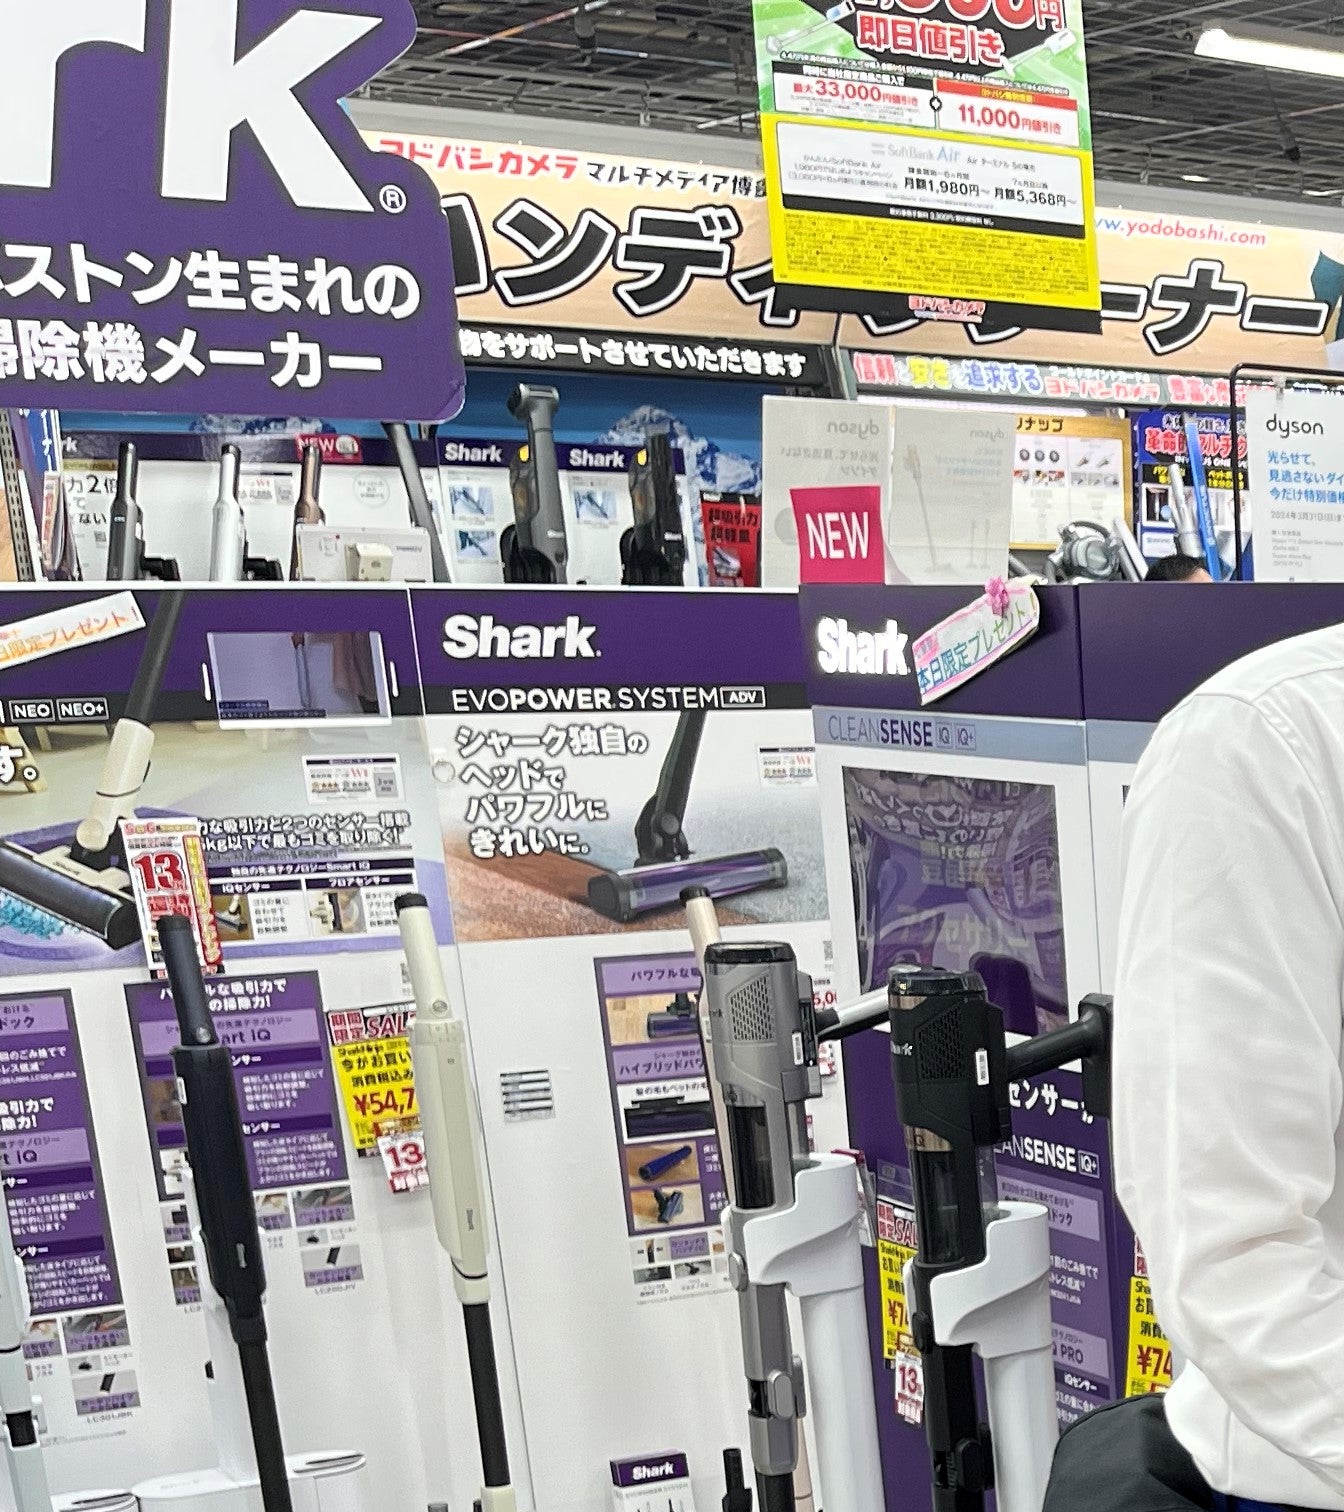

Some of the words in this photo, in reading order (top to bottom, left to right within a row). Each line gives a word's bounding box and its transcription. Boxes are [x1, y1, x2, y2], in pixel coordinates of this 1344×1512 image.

[0, 240, 421, 320] ストン生まれの
[1266, 413, 1324, 439] dyson
[443, 441, 502, 464] Shark
[569, 448, 626, 468] Shark
[804, 509, 871, 562] NEW
[443, 613, 603, 661] Shark
[816, 615, 911, 677] Shark
[13, 704, 51, 720] NEO
[60, 702, 105, 718] NEO+
[451, 687, 616, 712] EVOPOWER
[618, 687, 720, 712] SYSTEM
[728, 690, 758, 704] ADV
[457, 723, 648, 758] シャーク独自の
[828, 714, 933, 747] CLEANSENSE
[459, 760, 565, 790] ヘッドで
[465, 792, 608, 823] パワフルに
[468, 828, 592, 859] きれいに。
[631, 1461, 675, 1481] Shark
